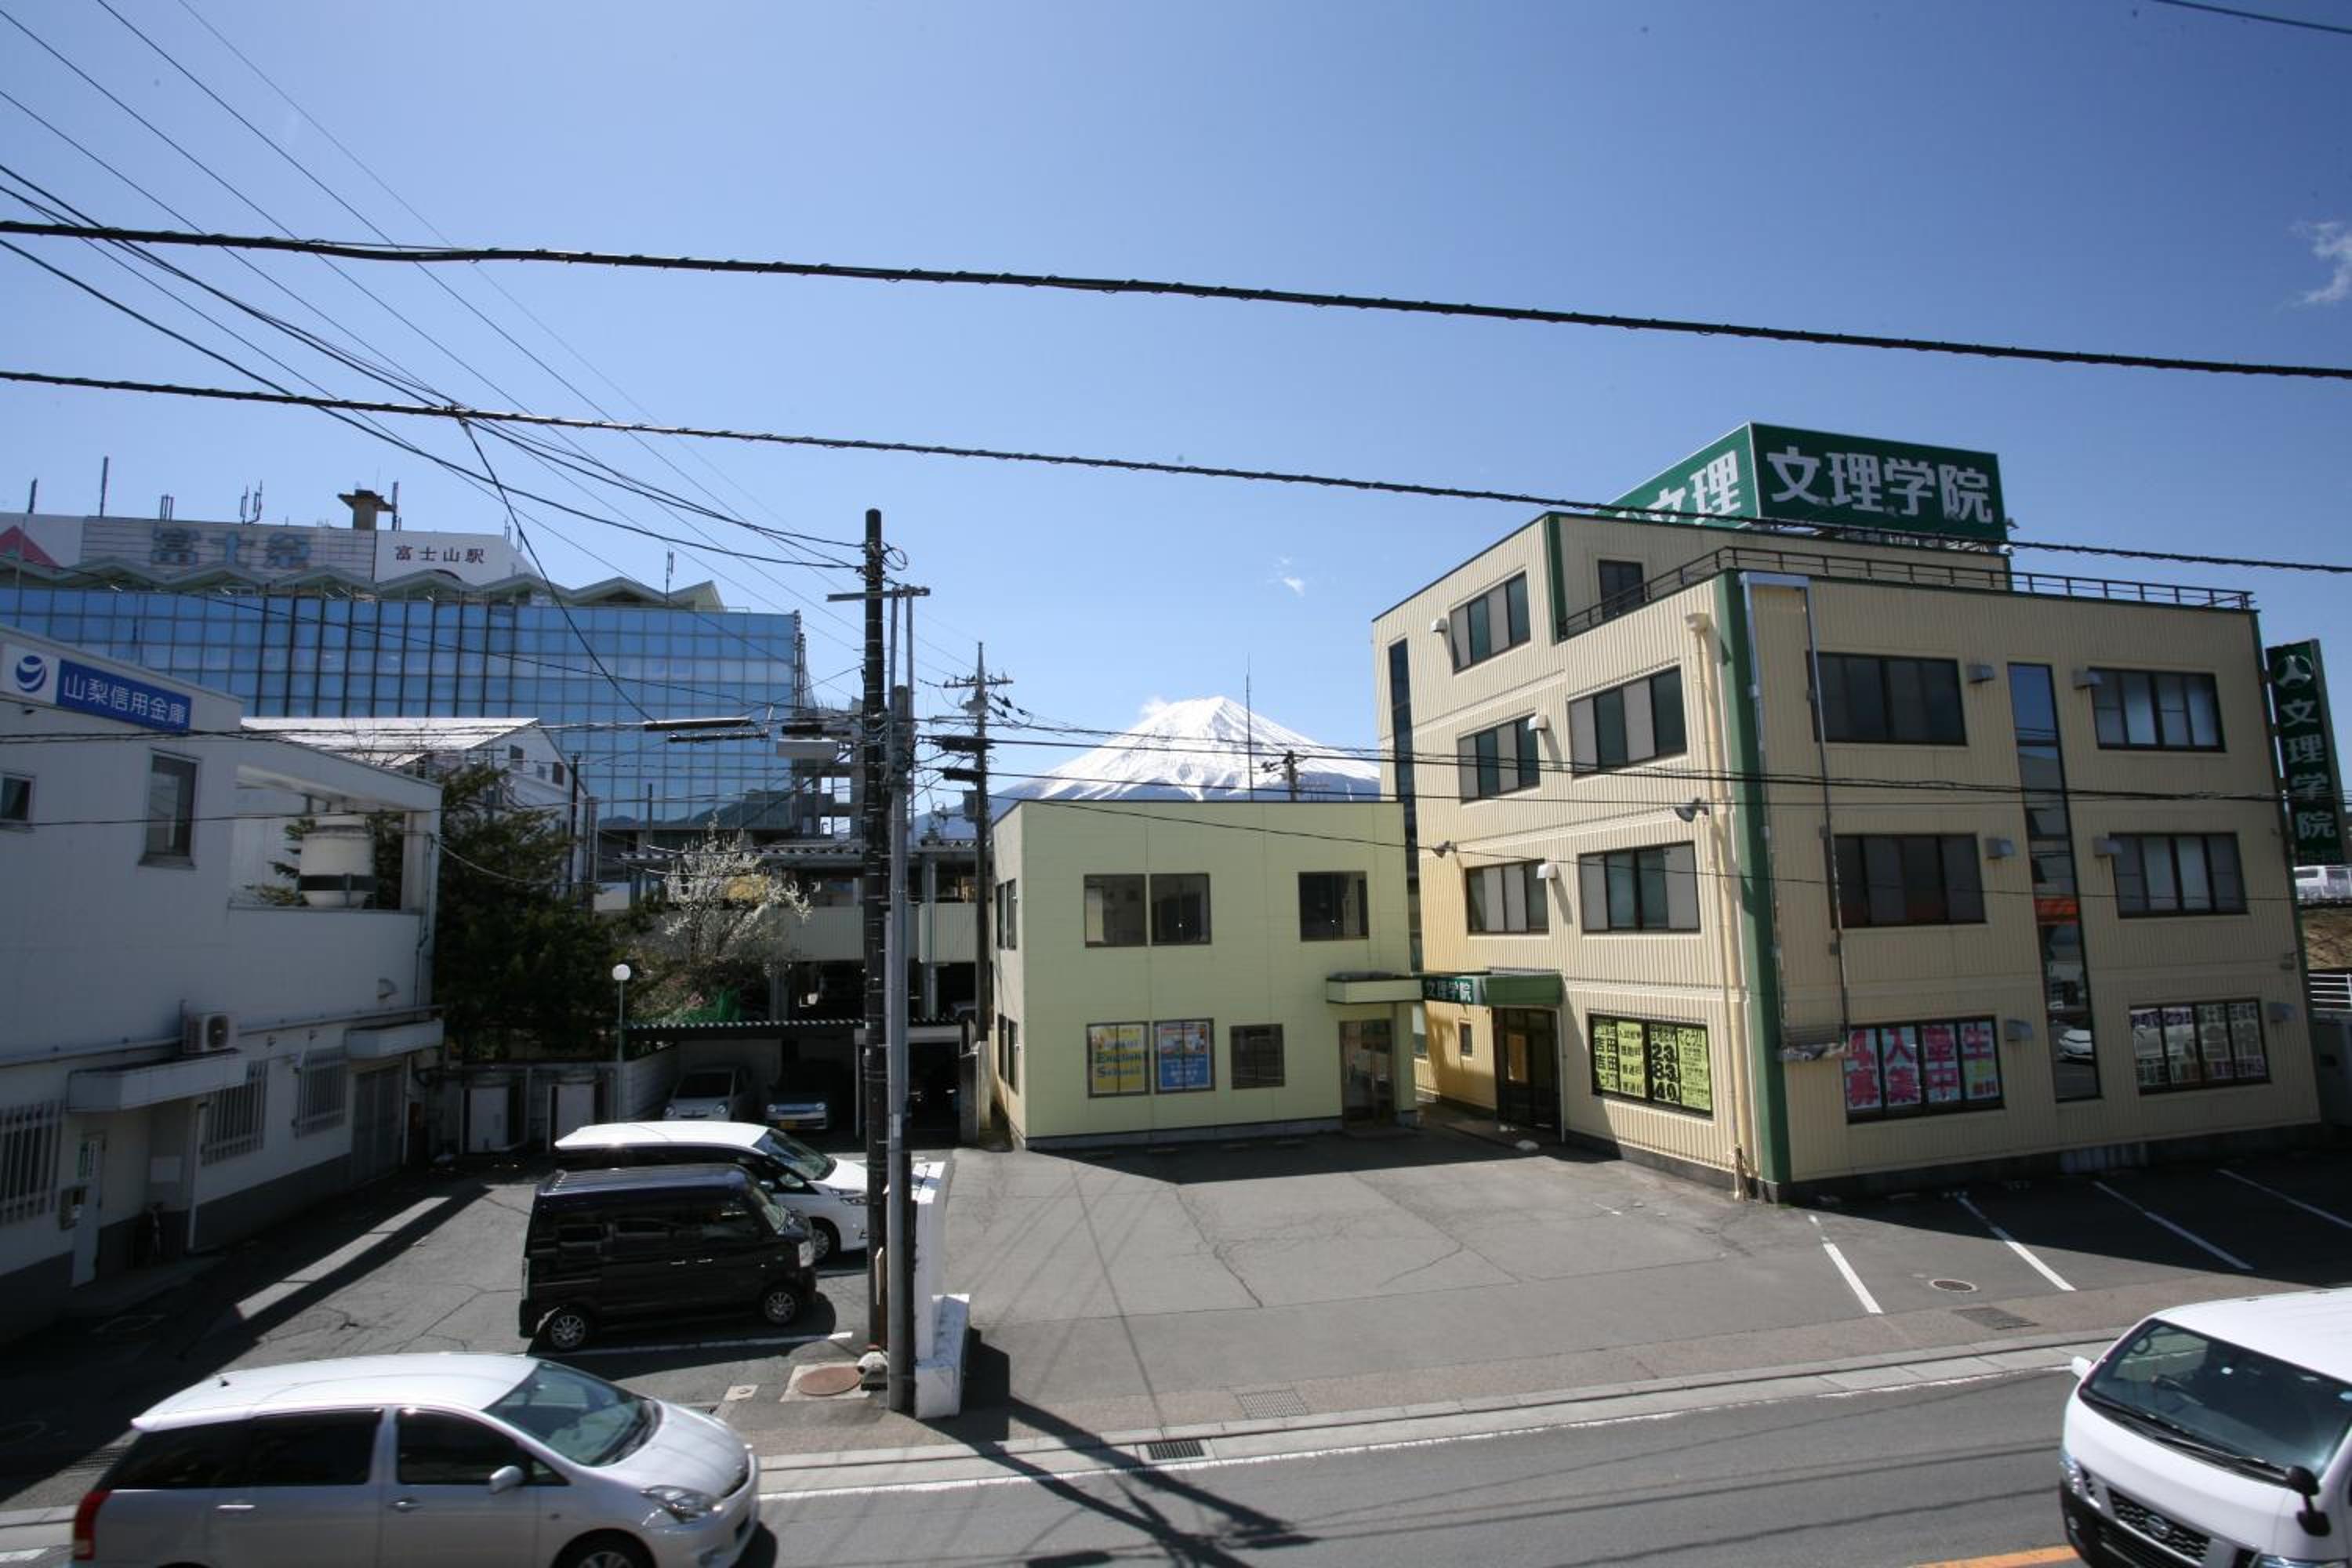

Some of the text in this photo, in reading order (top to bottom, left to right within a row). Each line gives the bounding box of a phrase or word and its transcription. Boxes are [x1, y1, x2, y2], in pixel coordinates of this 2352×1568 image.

[1766, 445, 1994, 524] 文理学院
[394, 545, 485, 564] 富士山駅
[64, 673, 187, 724] 山梨信用金庫
[2279, 698, 2336, 840] 文理学院
[1652, 1043, 1675, 1062] 23
